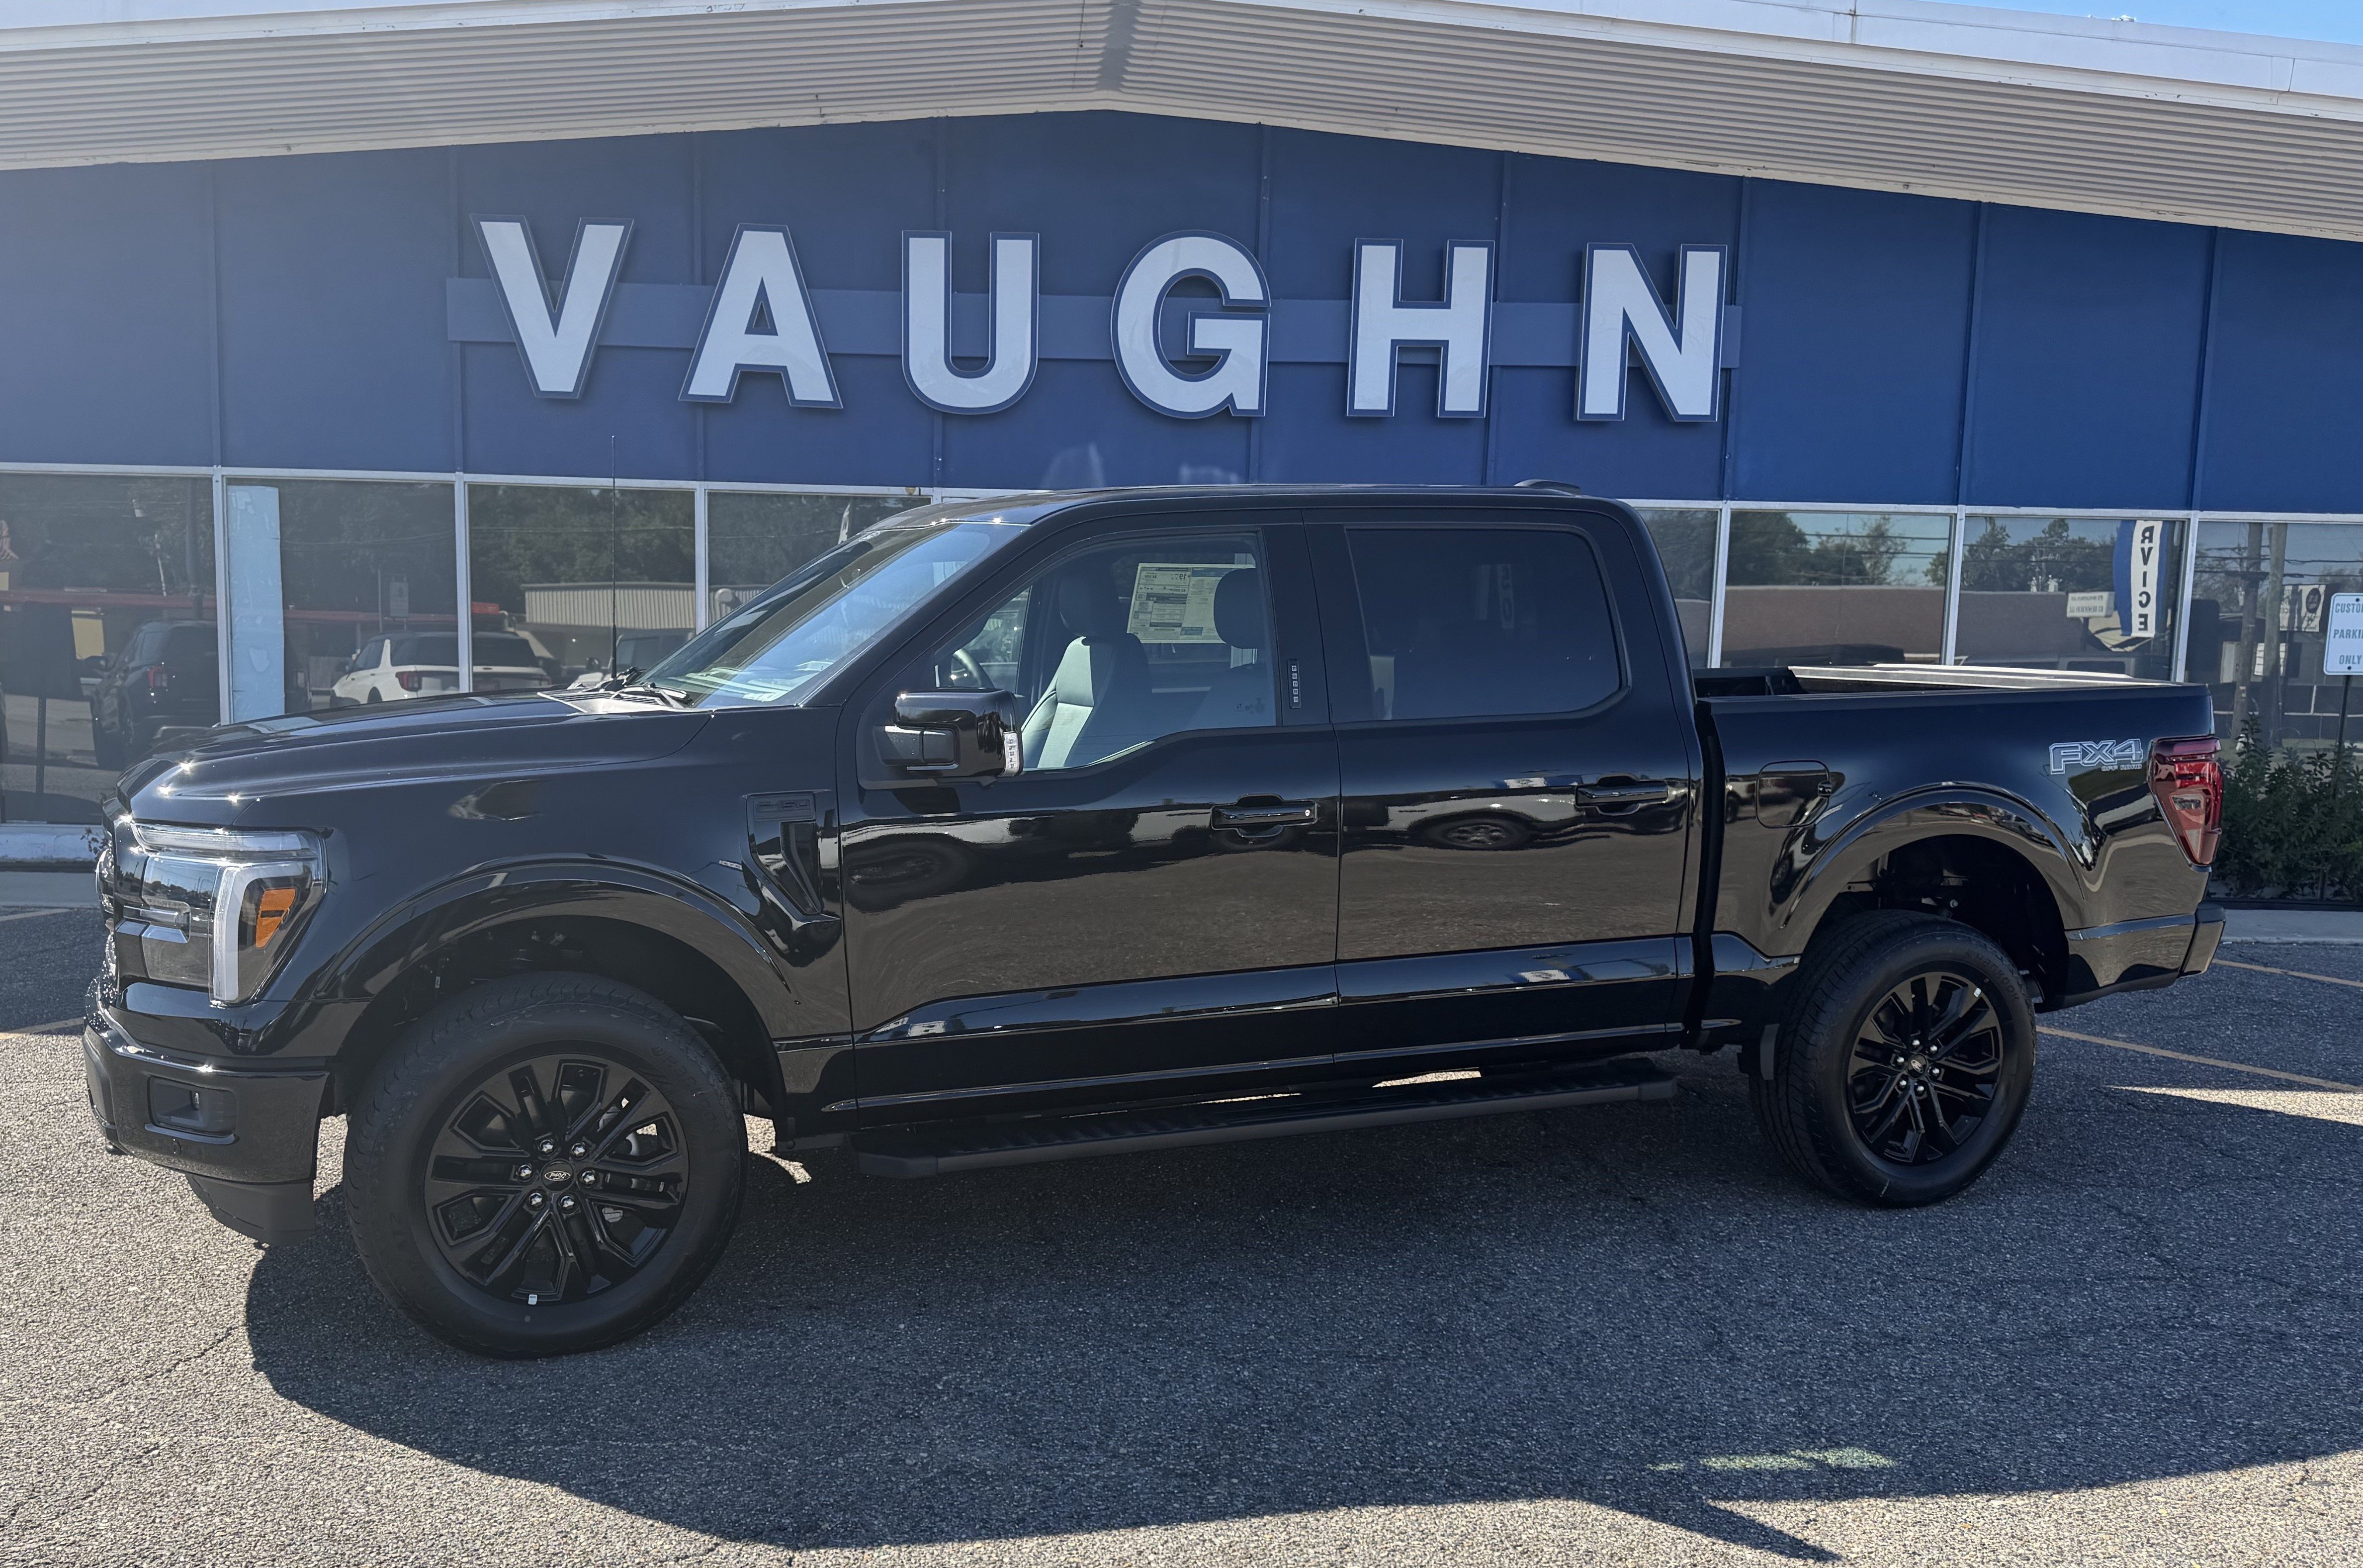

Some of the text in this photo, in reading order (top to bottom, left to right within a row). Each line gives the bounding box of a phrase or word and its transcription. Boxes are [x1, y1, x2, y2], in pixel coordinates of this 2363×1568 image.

[471, 215, 1727, 422] VAUGHN
[2335, 603, 2363, 613] CUSTO
[2339, 654, 2362, 665] ONLY
[2049, 739, 2143, 775] FX4
